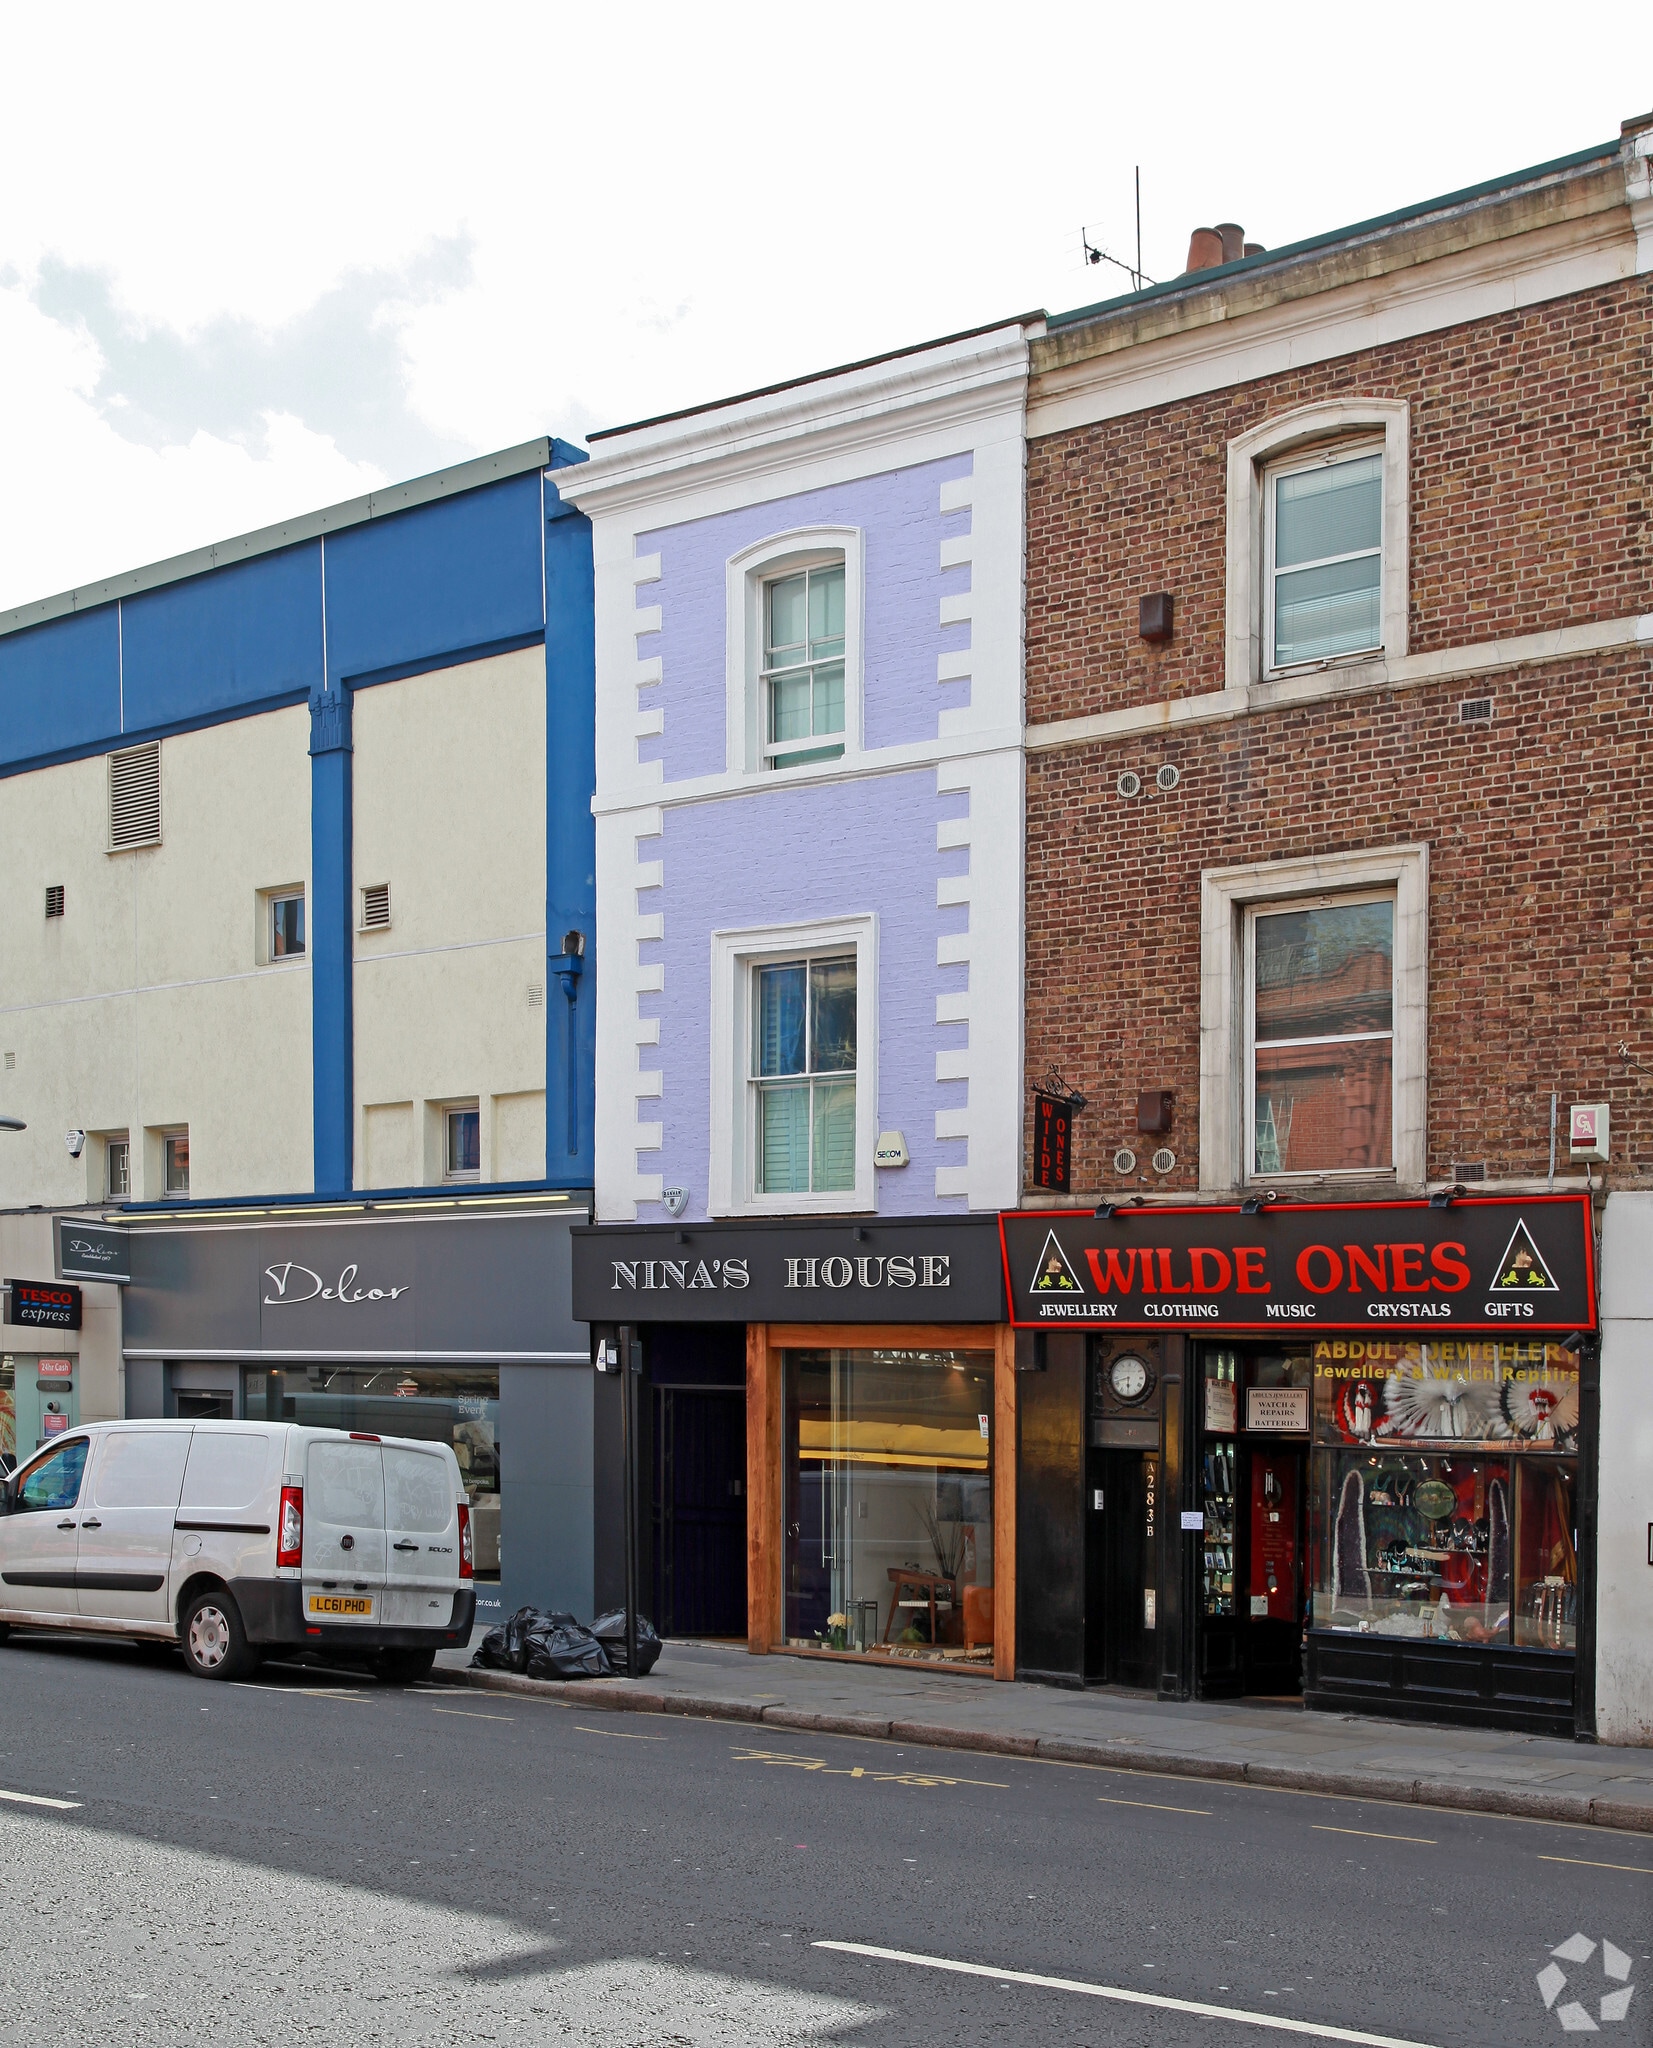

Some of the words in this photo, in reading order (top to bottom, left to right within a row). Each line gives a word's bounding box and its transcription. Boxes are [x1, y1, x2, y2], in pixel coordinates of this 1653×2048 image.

[1041, 1102, 1053, 1186] WILDE
[1056, 1118, 1066, 1182] ONES
[877, 1150, 901, 1159] SECOM
[610, 1258, 750, 1290] NINA'S
[783, 1255, 950, 1288] HOUSE
[1084, 1246, 1272, 1294] WILDE
[1296, 1241, 1471, 1293] ONES
[264, 1262, 409, 1304] Delcor
[19, 1288, 72, 1304] TESCO
[21, 1308, 71, 1323] express
[1039, 1303, 1118, 1318] JEWELLERY
[1143, 1303, 1219, 1317] CLOTHING
[1266, 1303, 1317, 1317] MUSIC
[1366, 1302, 1451, 1317] CRYSTALS
[1484, 1302, 1535, 1317] GIFTS
[1314, 1340, 1421, 1361] ABDUL'S
[1428, 1340, 1577, 1362] JEWELLERY
[55, 1363, 69, 1371] Cash
[1314, 1364, 1403, 1381] Jewellery
[1412, 1364, 1424, 1379] &
[1433, 1365, 1494, 1380] Watch
[1502, 1367, 1580, 1383] Repairs
[458, 1394, 489, 1405] Spring
[458, 1405, 485, 1415] Event
[316, 1598, 342, 1611] LC61
[344, 1599, 365, 1612] PHO
[731, 1752, 957, 1786] TAXIS
